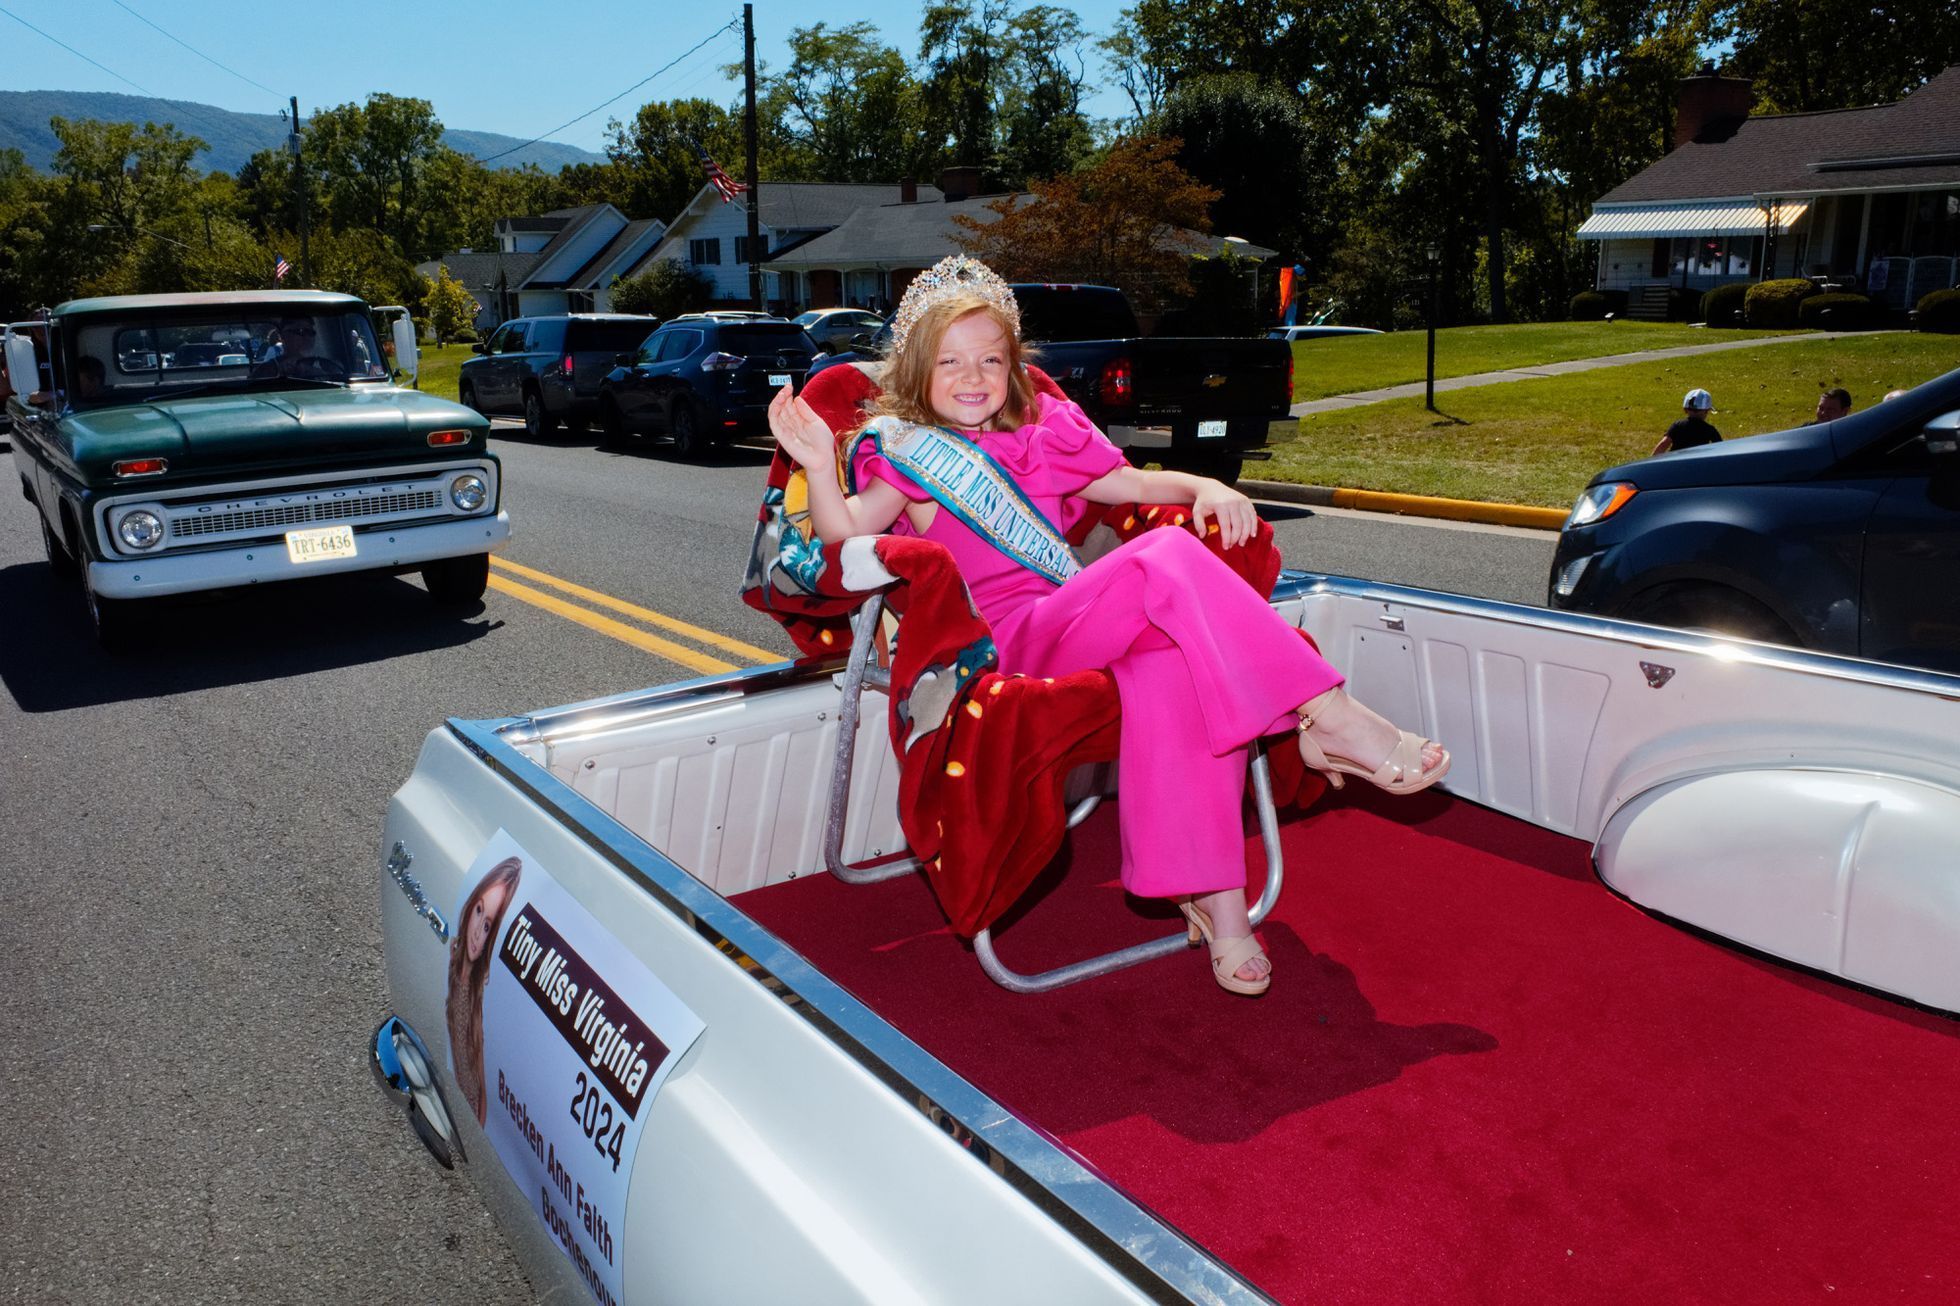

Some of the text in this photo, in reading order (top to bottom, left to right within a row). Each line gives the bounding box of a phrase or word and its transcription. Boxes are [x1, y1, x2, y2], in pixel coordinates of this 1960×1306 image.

[198, 484, 416, 512] CHEVROLET
[292, 535, 351, 554] TRT-6436
[909, 433, 1070, 578] LITTLE MISS UNIVERSAL
[507, 914, 648, 1098] Tiny Miss Virginia
[499, 1068, 613, 1267] Brecken Ann Faith
[570, 1071, 626, 1174] 2024
